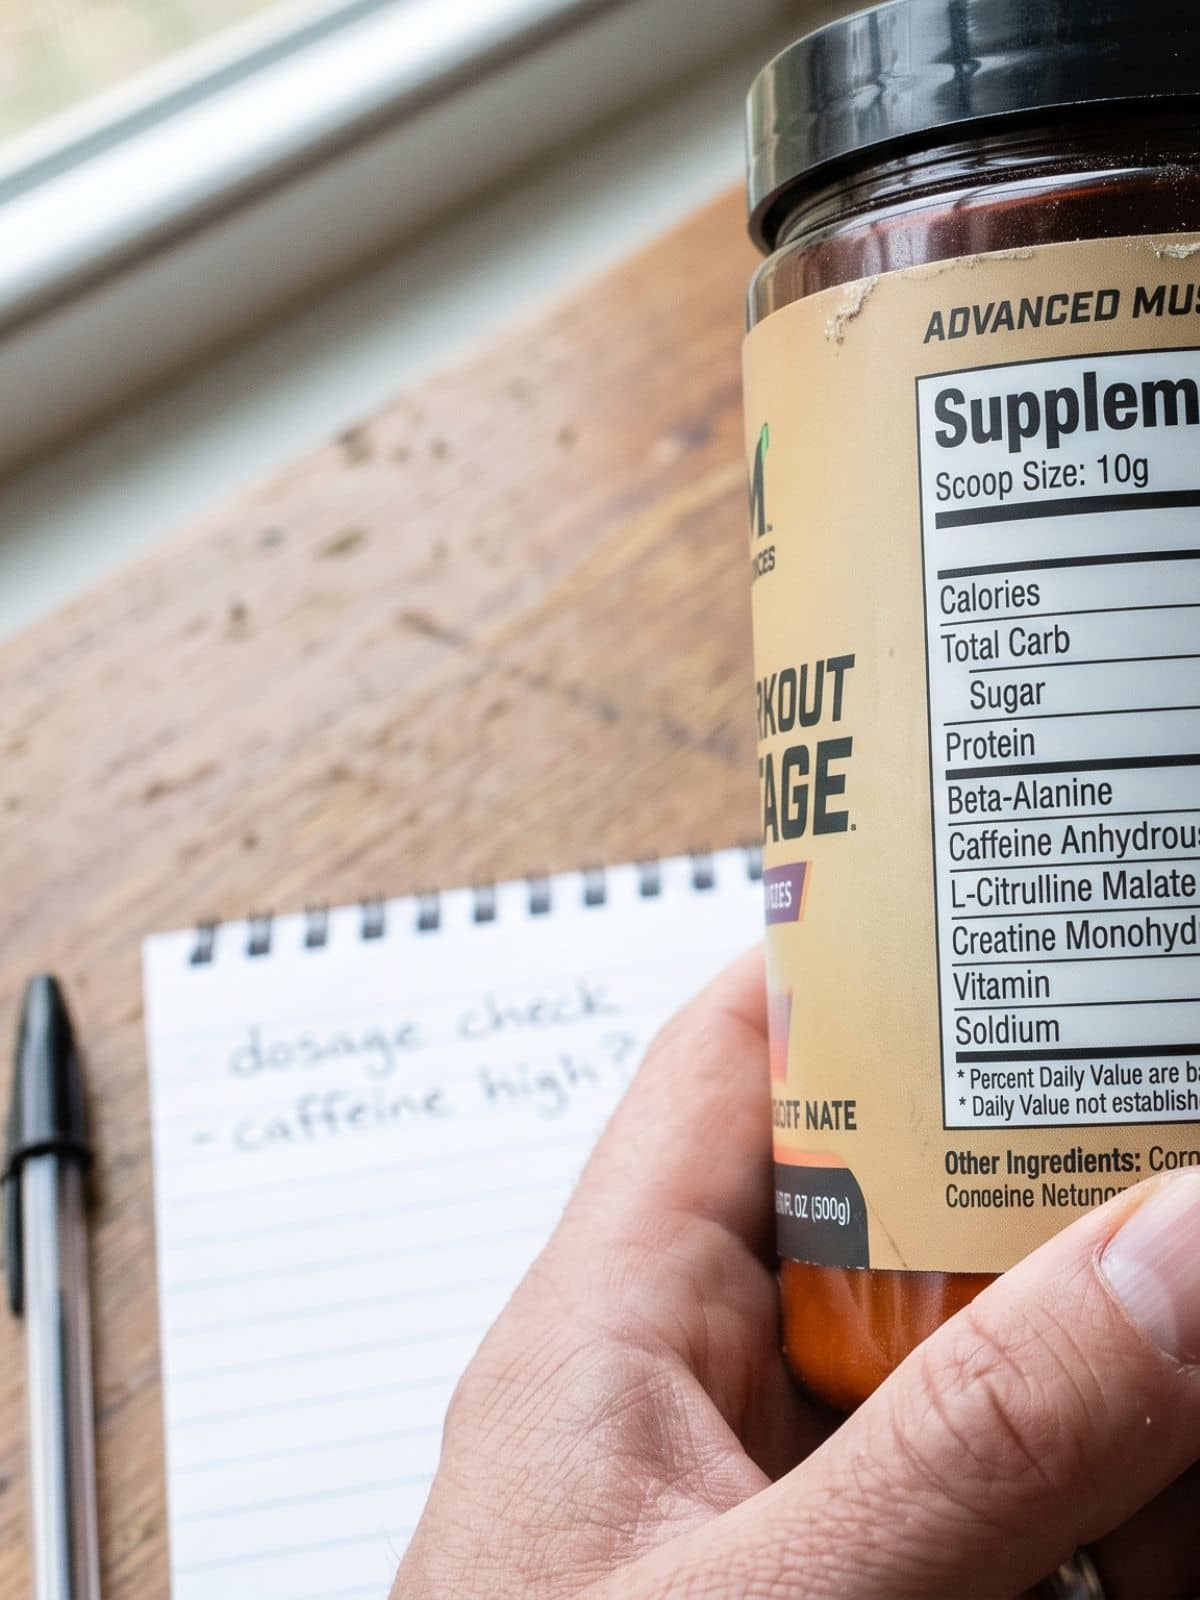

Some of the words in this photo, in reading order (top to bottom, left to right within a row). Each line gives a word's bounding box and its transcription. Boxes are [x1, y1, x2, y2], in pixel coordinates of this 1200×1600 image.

[923, 288, 1119, 343] ADVANCED
[935, 467, 1013, 502] Scoop
[1023, 461, 1086, 491] Size:
[1097, 454, 1150, 489] 10g
[940, 580, 1041, 615] Calories
[941, 630, 999, 663] Total
[1009, 624, 1070, 657] Carb
[970, 680, 1046, 714] Sugar
[946, 729, 1036, 764] Protein
[947, 780, 1113, 816] Beta-Alanine
[949, 827, 1053, 864] Caffeine
[950, 874, 1093, 909] L-Citrulline
[1102, 867, 1196, 903] Malate
[952, 922, 1056, 957] Creatine
[953, 970, 1050, 1002] Vitamin
[229, 1020, 421, 1079] dosage
[457, 980, 622, 1042] check
[955, 1014, 1060, 1047] Soldium
[970, 1068, 1035, 1090] Percent
[1040, 1066, 1085, 1092] Daily
[1090, 1064, 1142, 1086] Value
[1149, 1066, 1179, 1085] are
[232, 1084, 457, 1152] caffeine
[806, 1100, 857, 1131] NATE
[973, 1095, 1015, 1121] Daily
[1019, 1094, 1070, 1116] Value
[1076, 1093, 1107, 1115] not
[945, 1150, 1000, 1175] Other
[1007, 1146, 1141, 1180] Ingredients:
[811, 1196, 851, 1226] (500g)
[1042, 1182, 1129, 1207] Netuno
